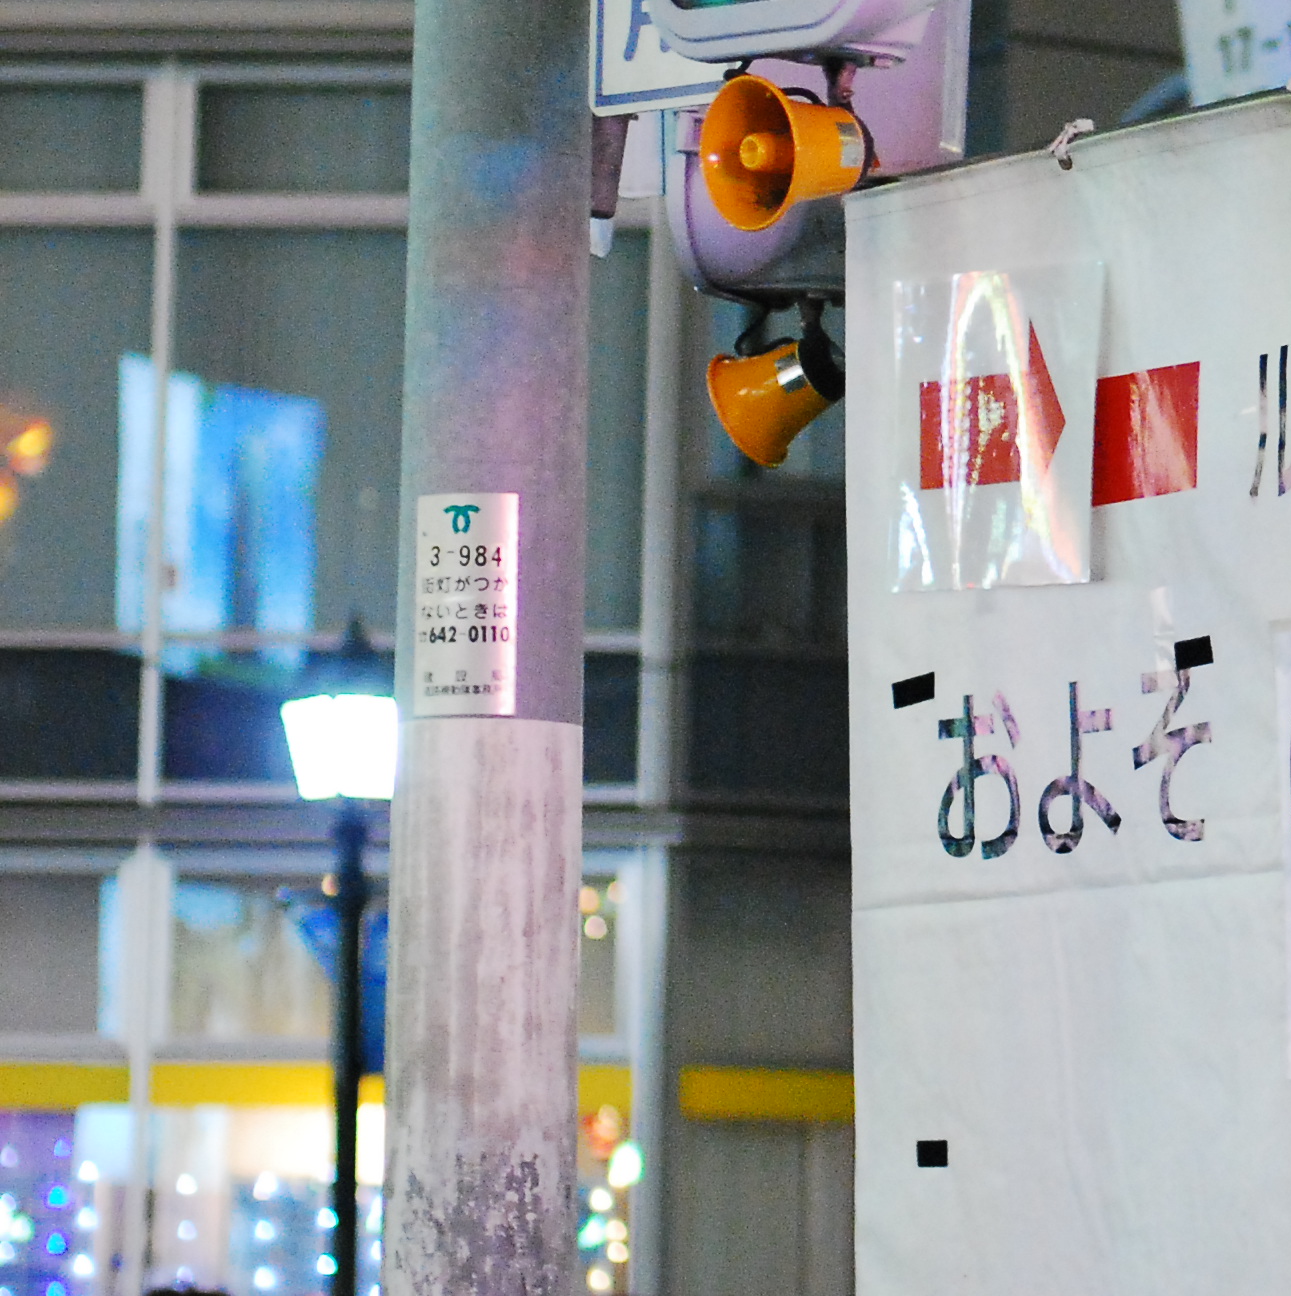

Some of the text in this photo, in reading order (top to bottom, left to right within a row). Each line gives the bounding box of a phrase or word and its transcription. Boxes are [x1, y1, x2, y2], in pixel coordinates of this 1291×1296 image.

[430, 545, 502, 567] 3-984
[421, 604, 508, 620] ないときは
[937, 659, 1213, 861] およそ
